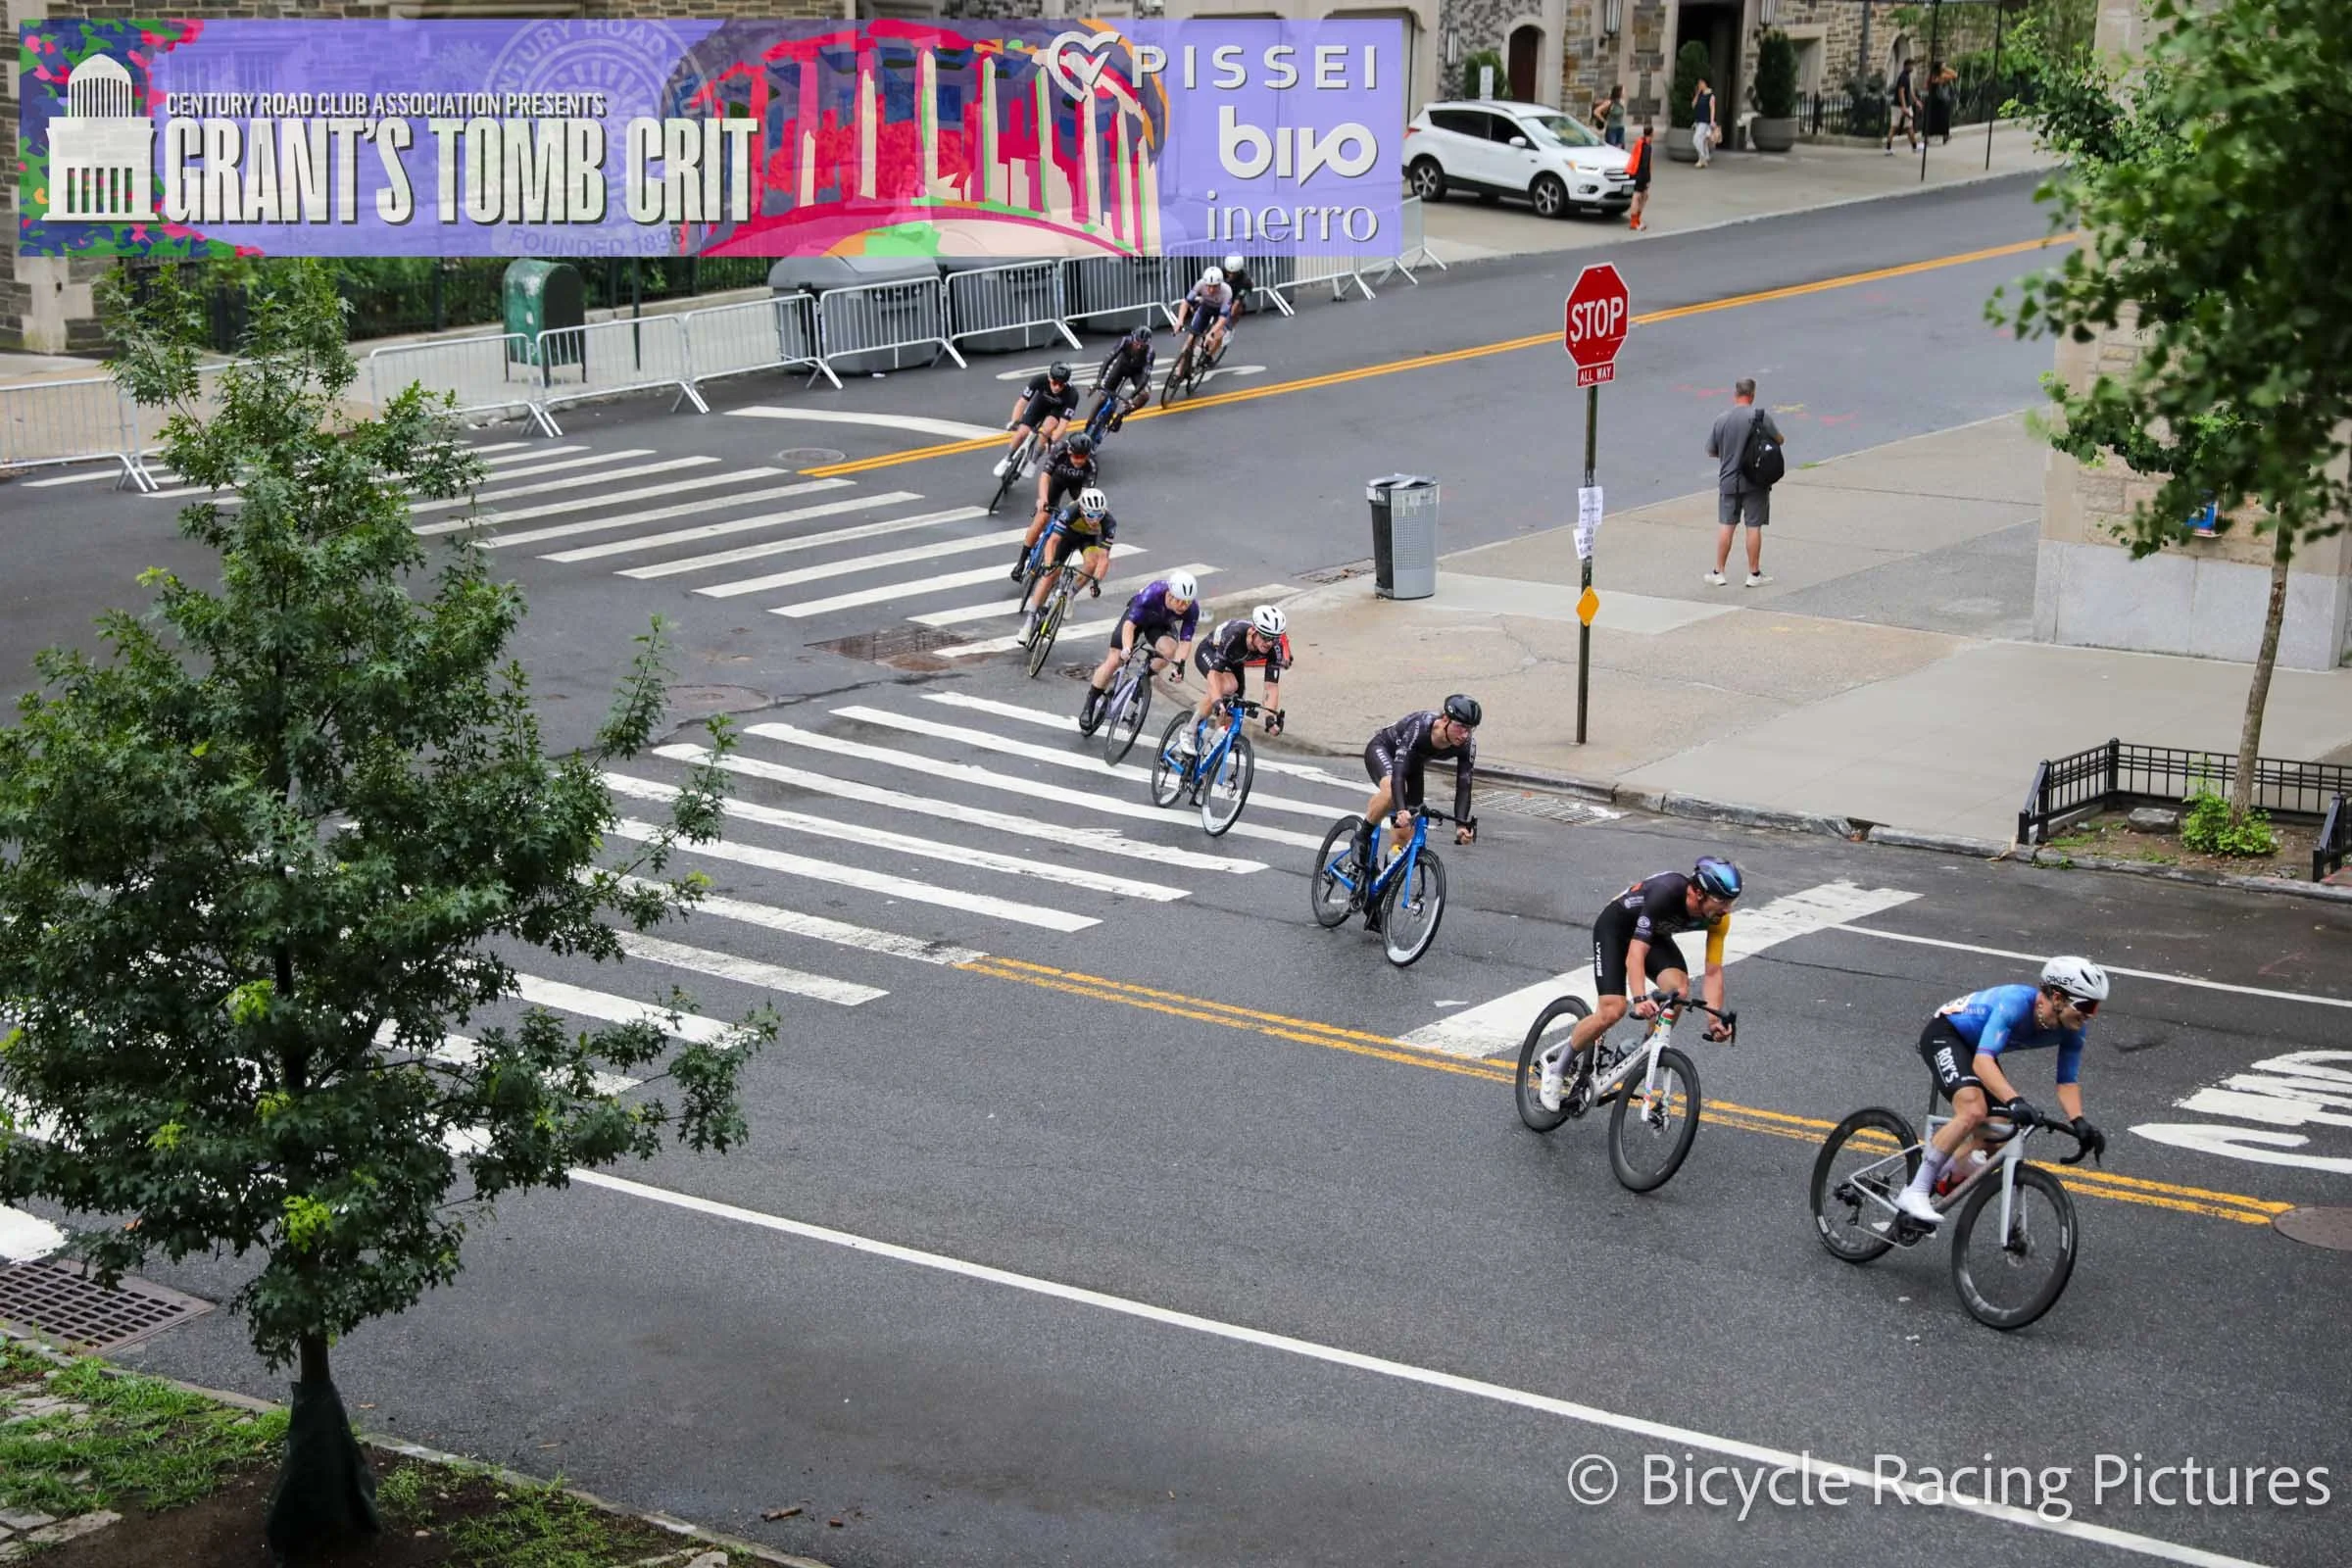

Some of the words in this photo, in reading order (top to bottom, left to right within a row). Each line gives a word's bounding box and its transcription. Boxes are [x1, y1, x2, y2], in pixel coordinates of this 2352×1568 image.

[1570, 297, 1623, 341] STOP
[1580, 369, 1593, 382] ALL
[1596, 366, 1612, 380] WAY
[1937, 1047, 1959, 1084] ROY'S
